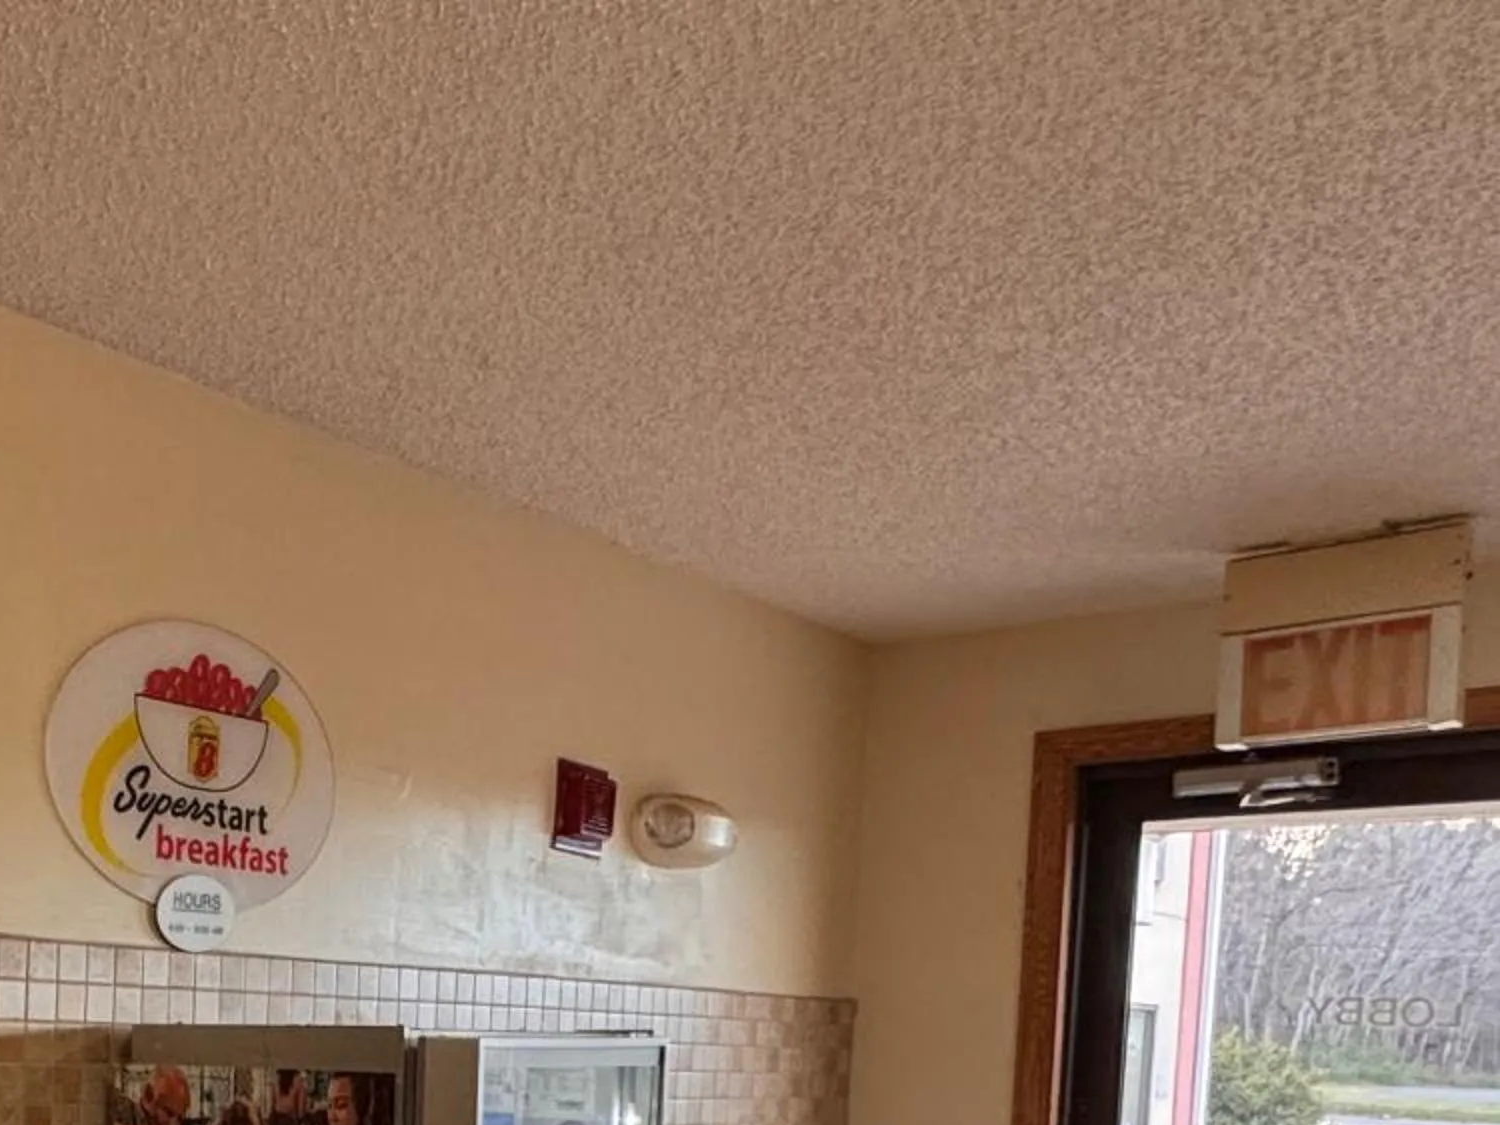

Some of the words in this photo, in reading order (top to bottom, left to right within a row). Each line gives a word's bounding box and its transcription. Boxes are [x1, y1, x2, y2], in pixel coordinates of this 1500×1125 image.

[1243, 614, 1430, 736] EXIT
[113, 764, 268, 840] Superstart
[155, 823, 290, 876] breakfast
[172, 891, 222, 912] HOURS
